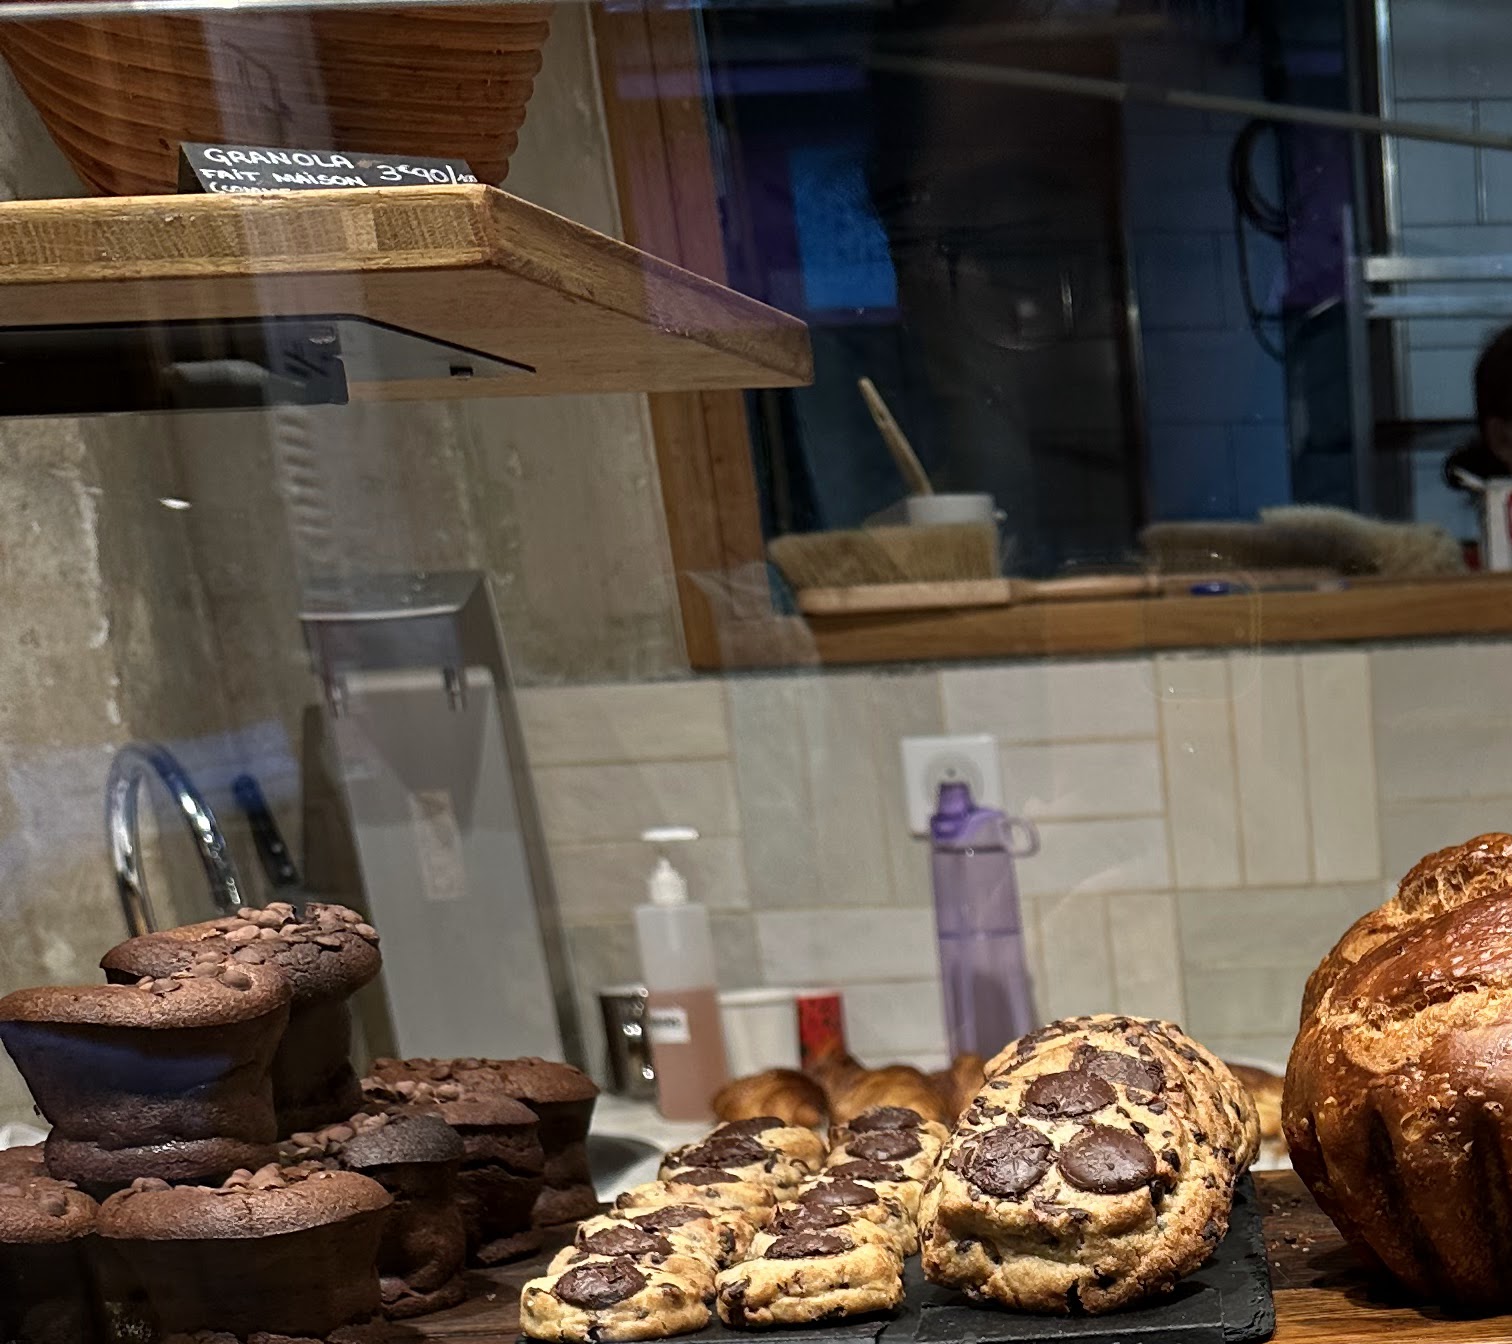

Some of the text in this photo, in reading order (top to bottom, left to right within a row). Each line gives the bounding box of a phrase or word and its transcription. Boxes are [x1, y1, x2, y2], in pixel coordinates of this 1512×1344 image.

[203, 148, 355, 169] GRANOLA
[200, 168, 260, 181] FAIT
[272, 171, 368, 187] MAISON
